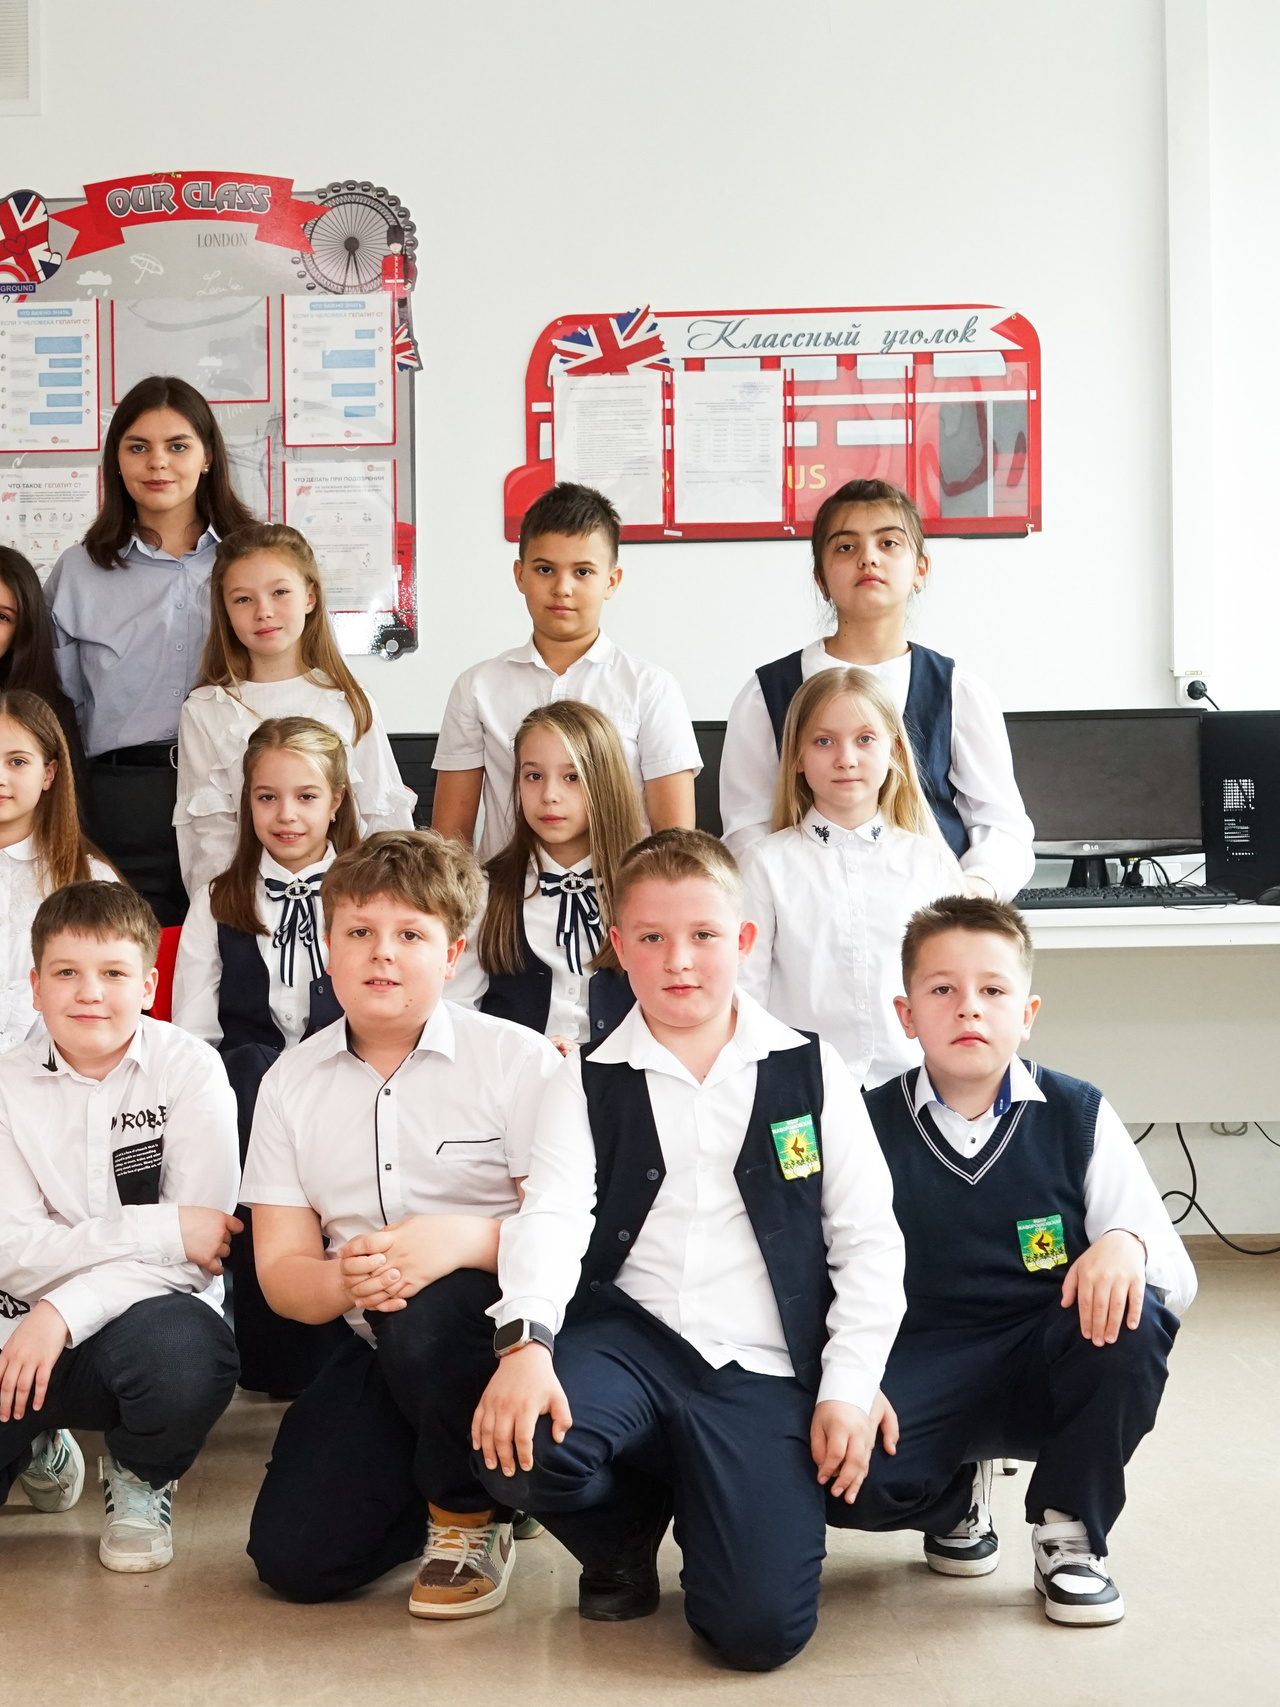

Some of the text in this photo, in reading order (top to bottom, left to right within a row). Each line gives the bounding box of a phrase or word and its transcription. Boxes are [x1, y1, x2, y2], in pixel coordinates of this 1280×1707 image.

[106, 181, 271, 217] OUR CLASS
[197, 232, 248, 248] LONDON
[687, 315, 979, 355] Классный уголок
[787, 464, 827, 489] US
